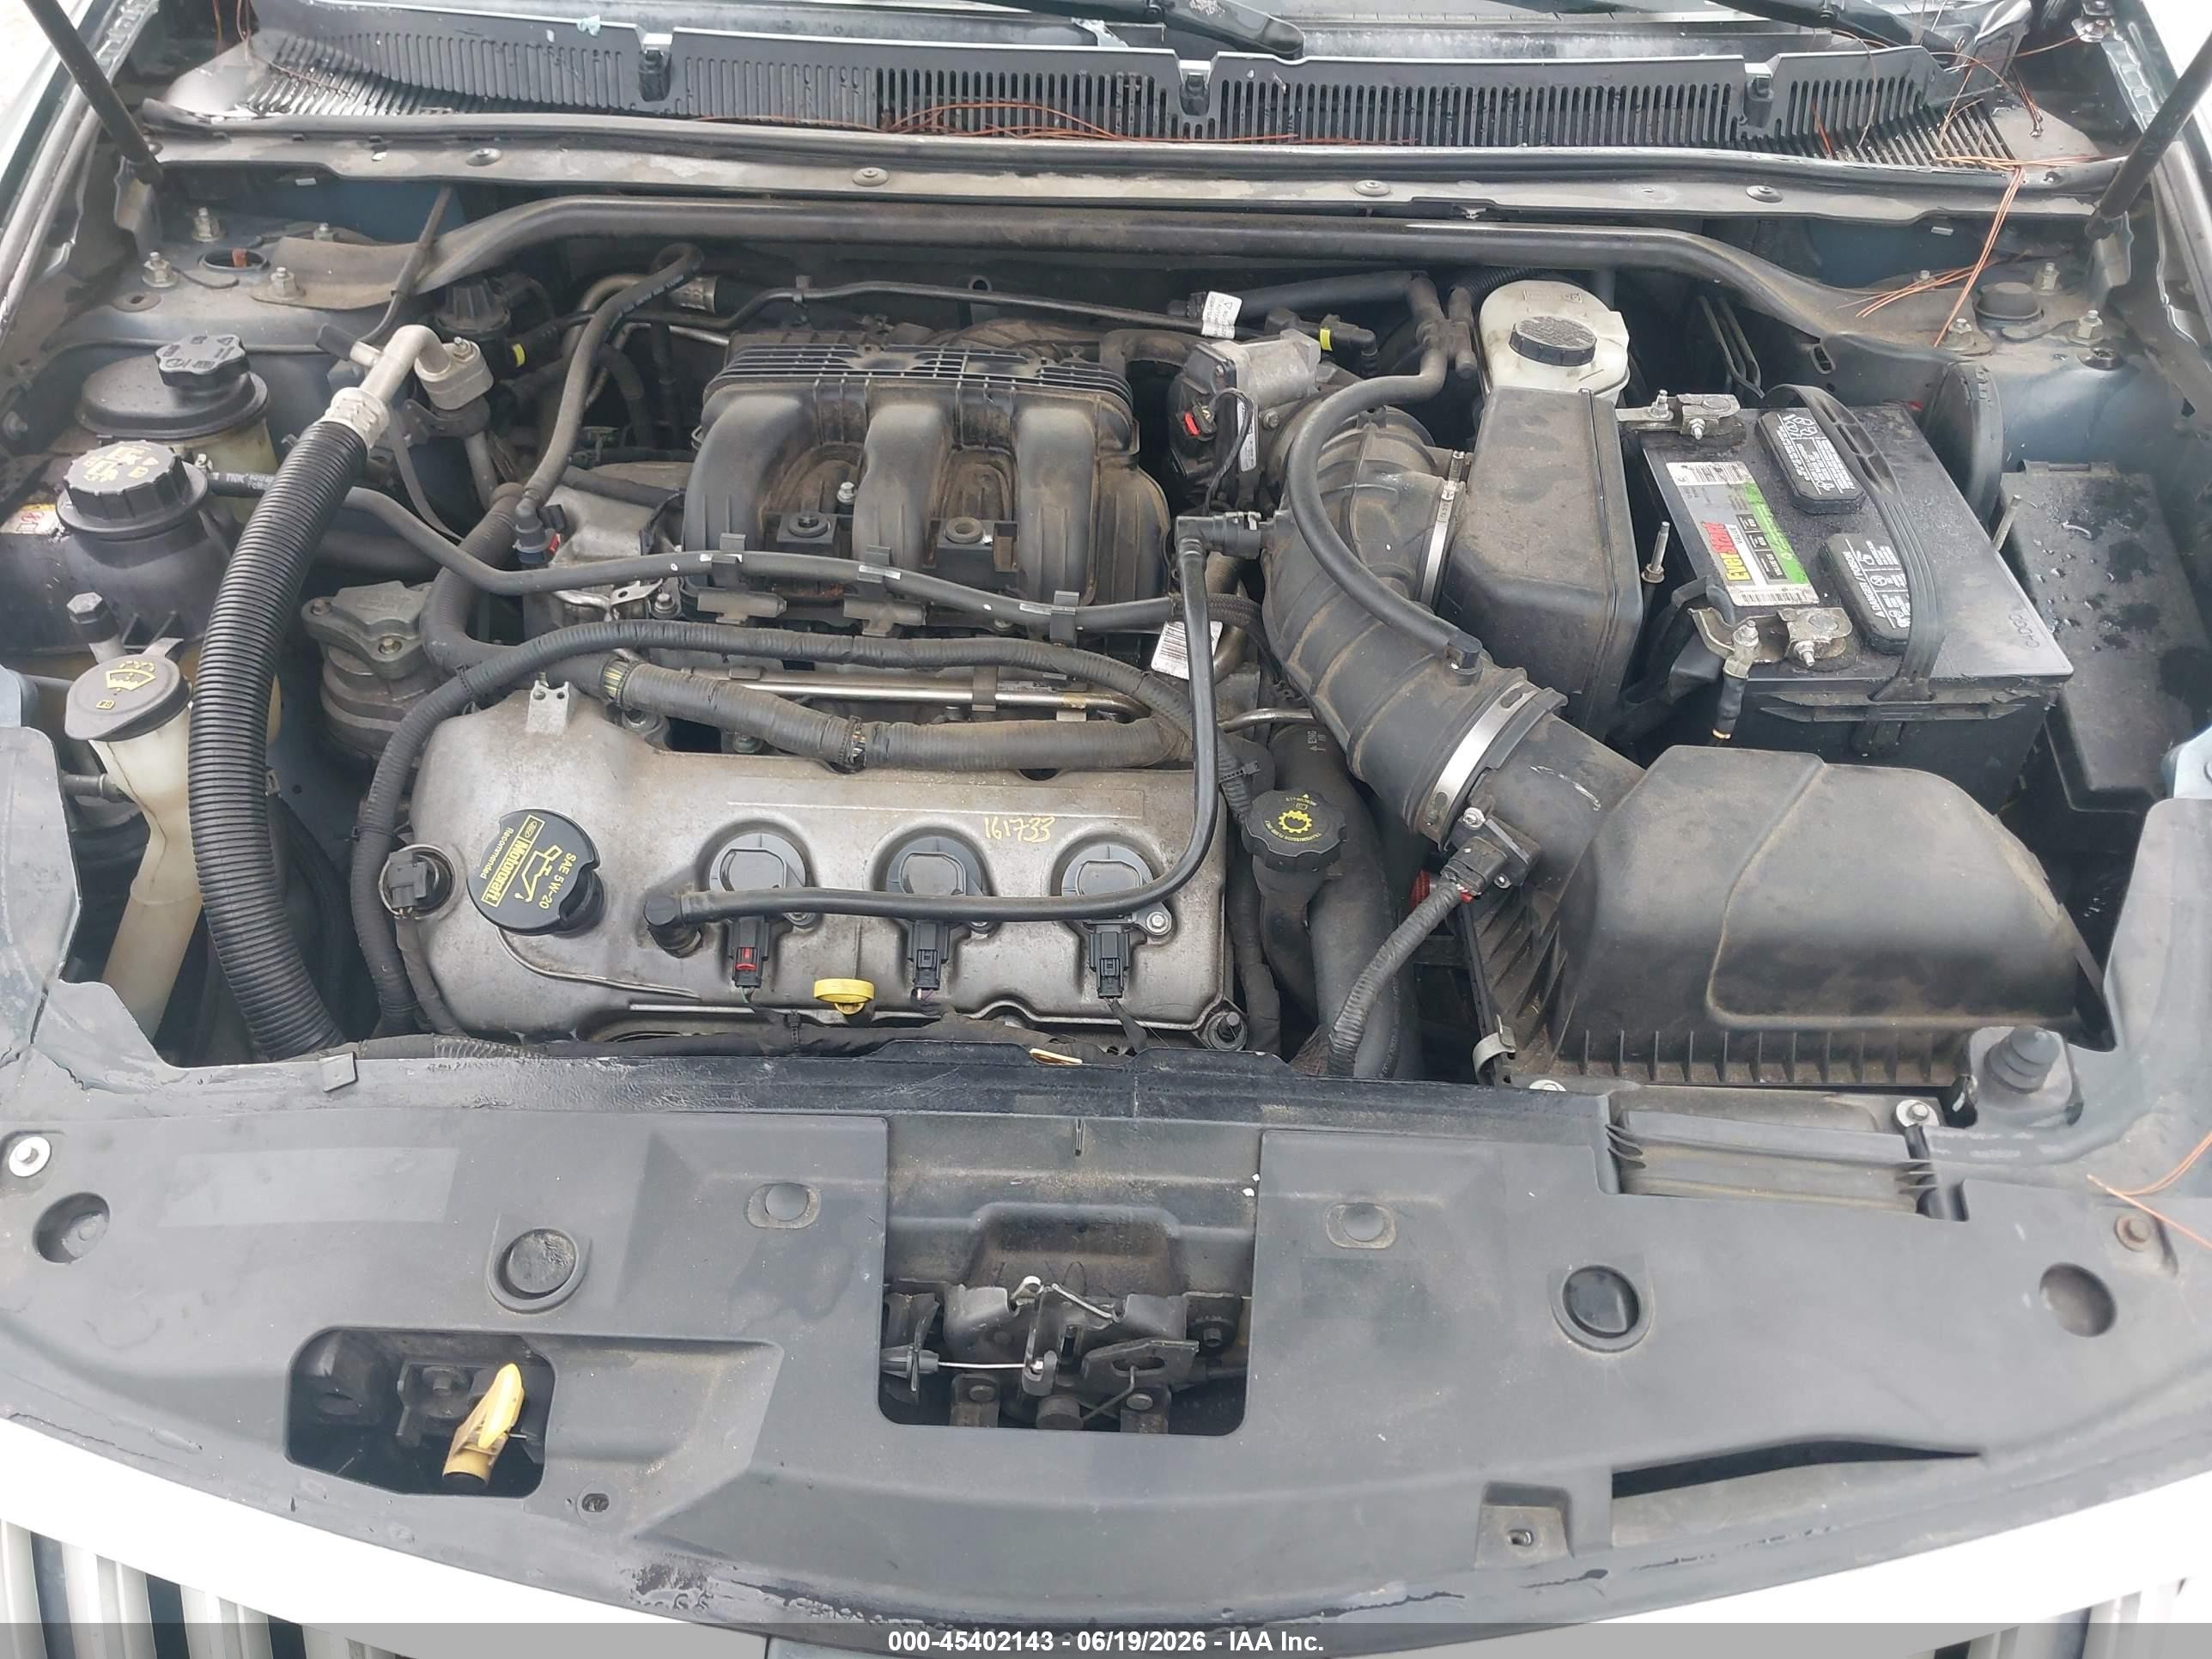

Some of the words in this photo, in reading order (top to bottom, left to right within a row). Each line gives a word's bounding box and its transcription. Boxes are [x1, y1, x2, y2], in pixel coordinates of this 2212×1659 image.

[1701, 520, 1752, 581] EverStart
[1728, 526, 1744, 544] VALUE
[1859, 582, 1882, 611] DANGER
[984, 816, 1056, 843] 161733
[479, 827, 514, 880] Recommended
[558, 852, 577, 875] SAE
[485, 838, 529, 904] Motorcraft
[539, 874, 565, 910] 5W-20
